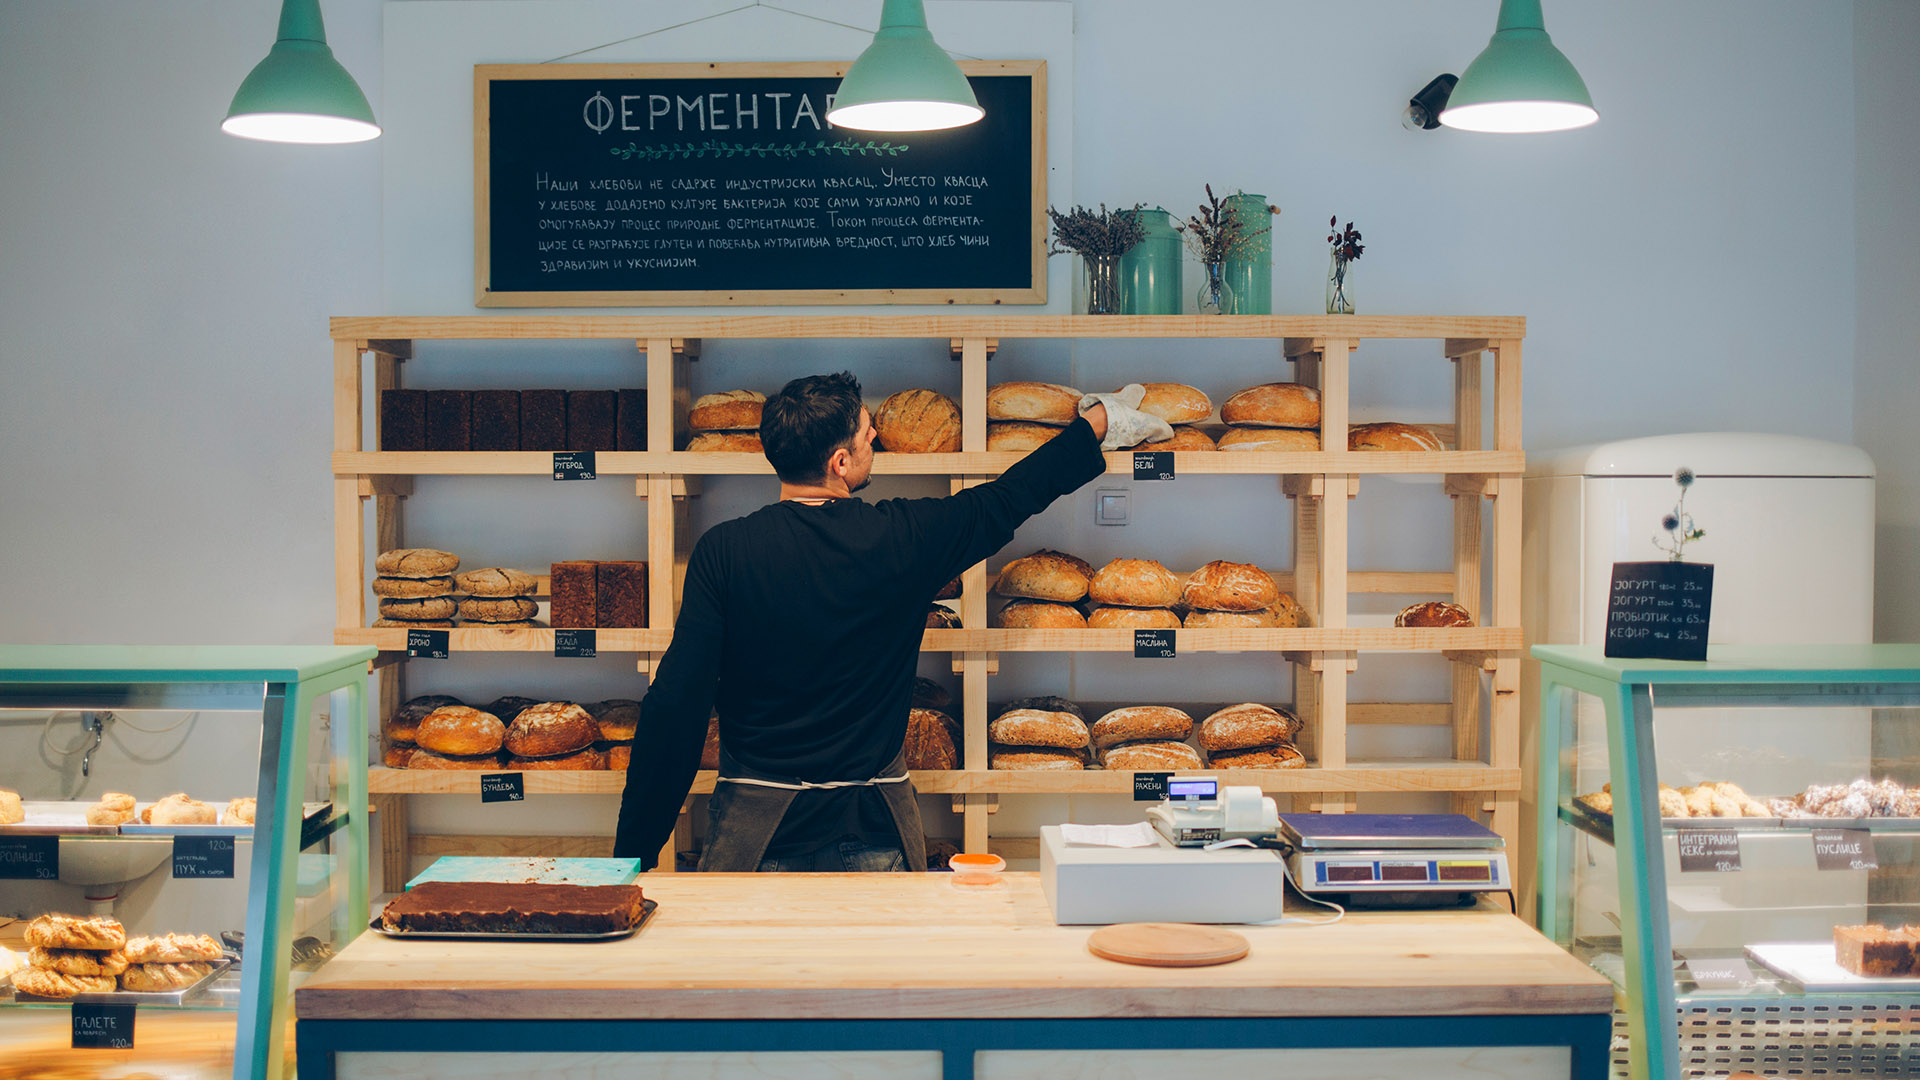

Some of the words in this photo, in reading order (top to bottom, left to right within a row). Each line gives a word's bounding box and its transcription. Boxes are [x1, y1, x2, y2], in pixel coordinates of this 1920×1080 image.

[589, 179, 643, 191] ХЛЕБОВИ
[649, 179, 664, 190] НЕ
[671, 178, 717, 191] САДРЖЕ
[725, 178, 817, 191] ИНДУСТРИЈСКИ
[944, 176, 989, 189] КВАСЦА
[550, 200, 597, 211] ХЛЕБОВЕ
[605, 199, 666, 211] ДОДАЈЕМО
[671, 199, 718, 211] КУЛТУРЕ
[723, 197, 787, 210] БАКТЕРИЈА
[794, 197, 820, 208] КОЈЕ
[827, 197, 860, 208] САМИ
[866, 195, 921, 208] УЗГАЈАМО
[929, 195, 938, 206] И
[943, 195, 973, 206] КОЈЕ
[621, 219, 661, 231] ПРОЦЕС
[667, 219, 721, 231] ПРИРОДНЕ
[871, 216, 918, 228] ПРОЦЕСА
[922, 214, 985, 227] ФЕРМЕНТА-
[538, 239, 567, 252] ЦИЈЕ
[572, 239, 585, 250] СЕ
[654, 239, 693, 250] ГЛУТЕН
[697, 238, 705, 249] И
[764, 236, 831, 249] НУТРИТИВНА
[901, 235, 925, 247] ШТО
[928, 234, 956, 247] ХЛЕБ
[960, 234, 990, 247] ЧИНИ
[540, 260, 610, 273] ЗДРАВИЈИМ
[613, 259, 622, 269] И
[1134, 461, 1154, 470] БЕЛИ
[1614, 580, 1657, 591] ЈОГУРТ
[1613, 595, 1656, 606] ЈОГУРТ
[1611, 611, 1670, 623] ПРОБИОТИК
[1610, 626, 1650, 639] КЕФИР
[409, 638, 430, 647] ХРОНО
[1136, 639, 1168, 647] МАСЛИНА
[482, 783, 515, 792] БУНДЕВА
[1680, 845, 1705, 856] КЕКС
[1816, 842, 1863, 855] ПУСЛИЦЕ
[74, 1016, 117, 1029] ГАЛЕТЕ
